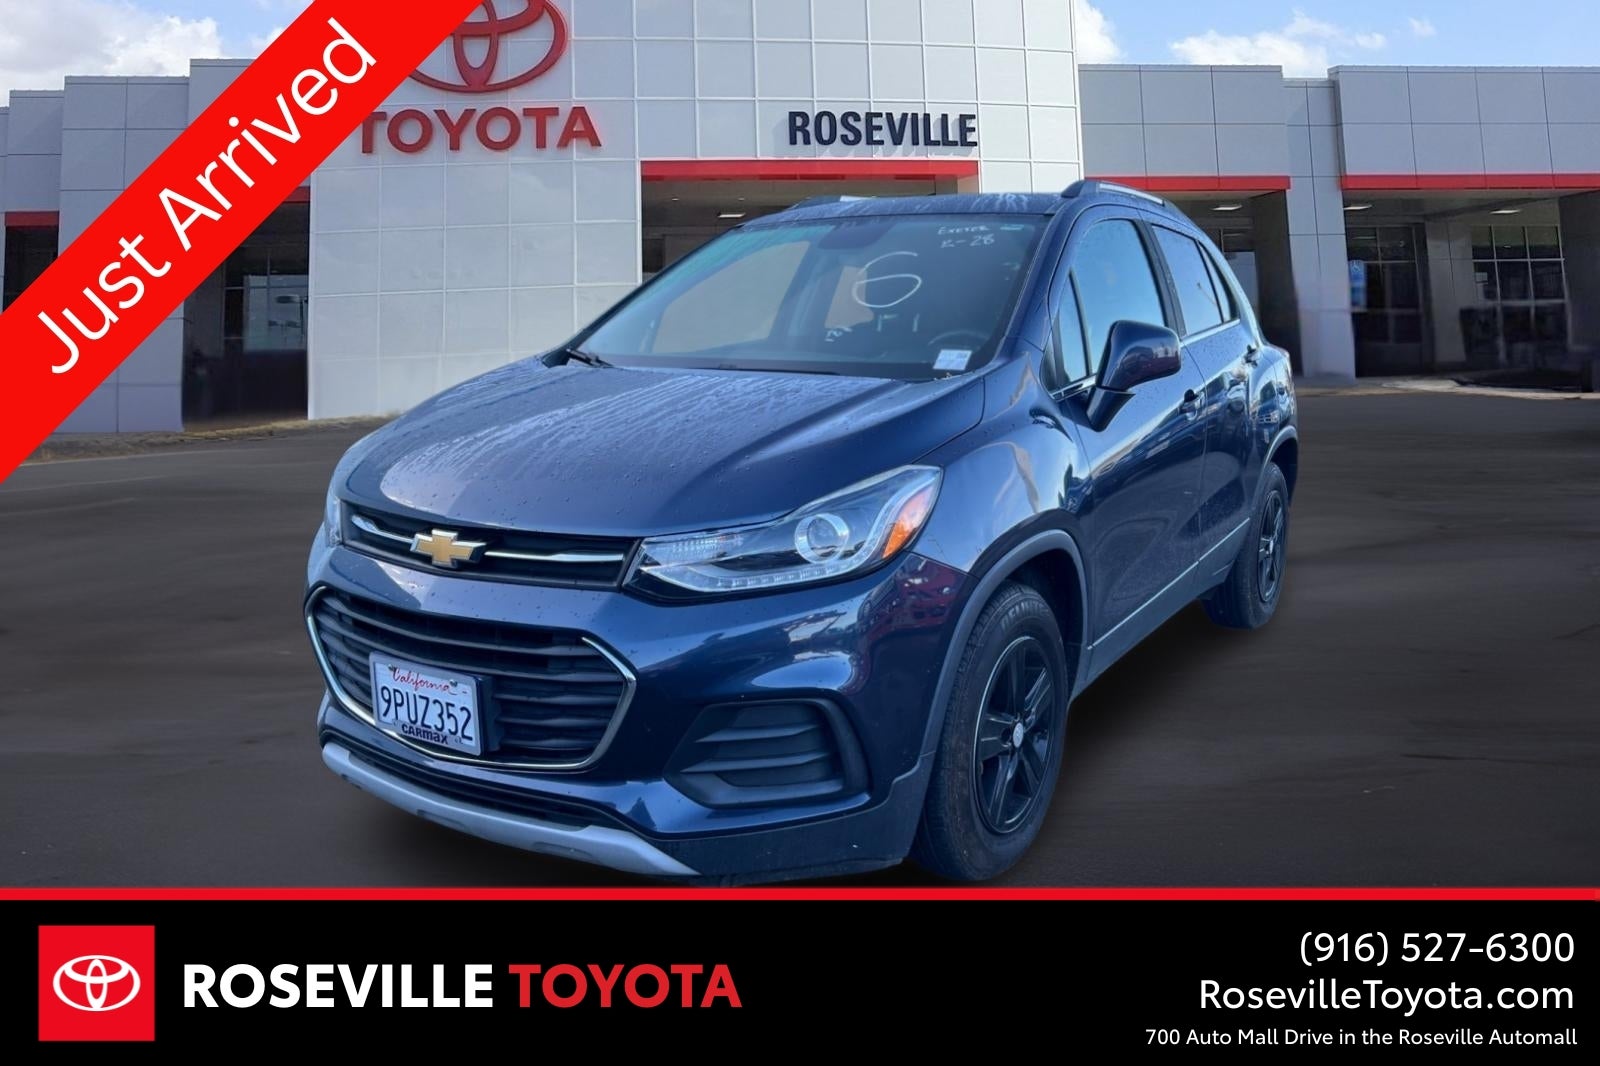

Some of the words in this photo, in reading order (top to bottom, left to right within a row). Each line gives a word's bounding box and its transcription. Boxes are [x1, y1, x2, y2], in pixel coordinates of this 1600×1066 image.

[361, 106, 602, 154] TOYOTA
[788, 111, 978, 147] ROSEVILLE
[392, 667, 458, 695] California
[381, 686, 473, 741] 9PUZ352
